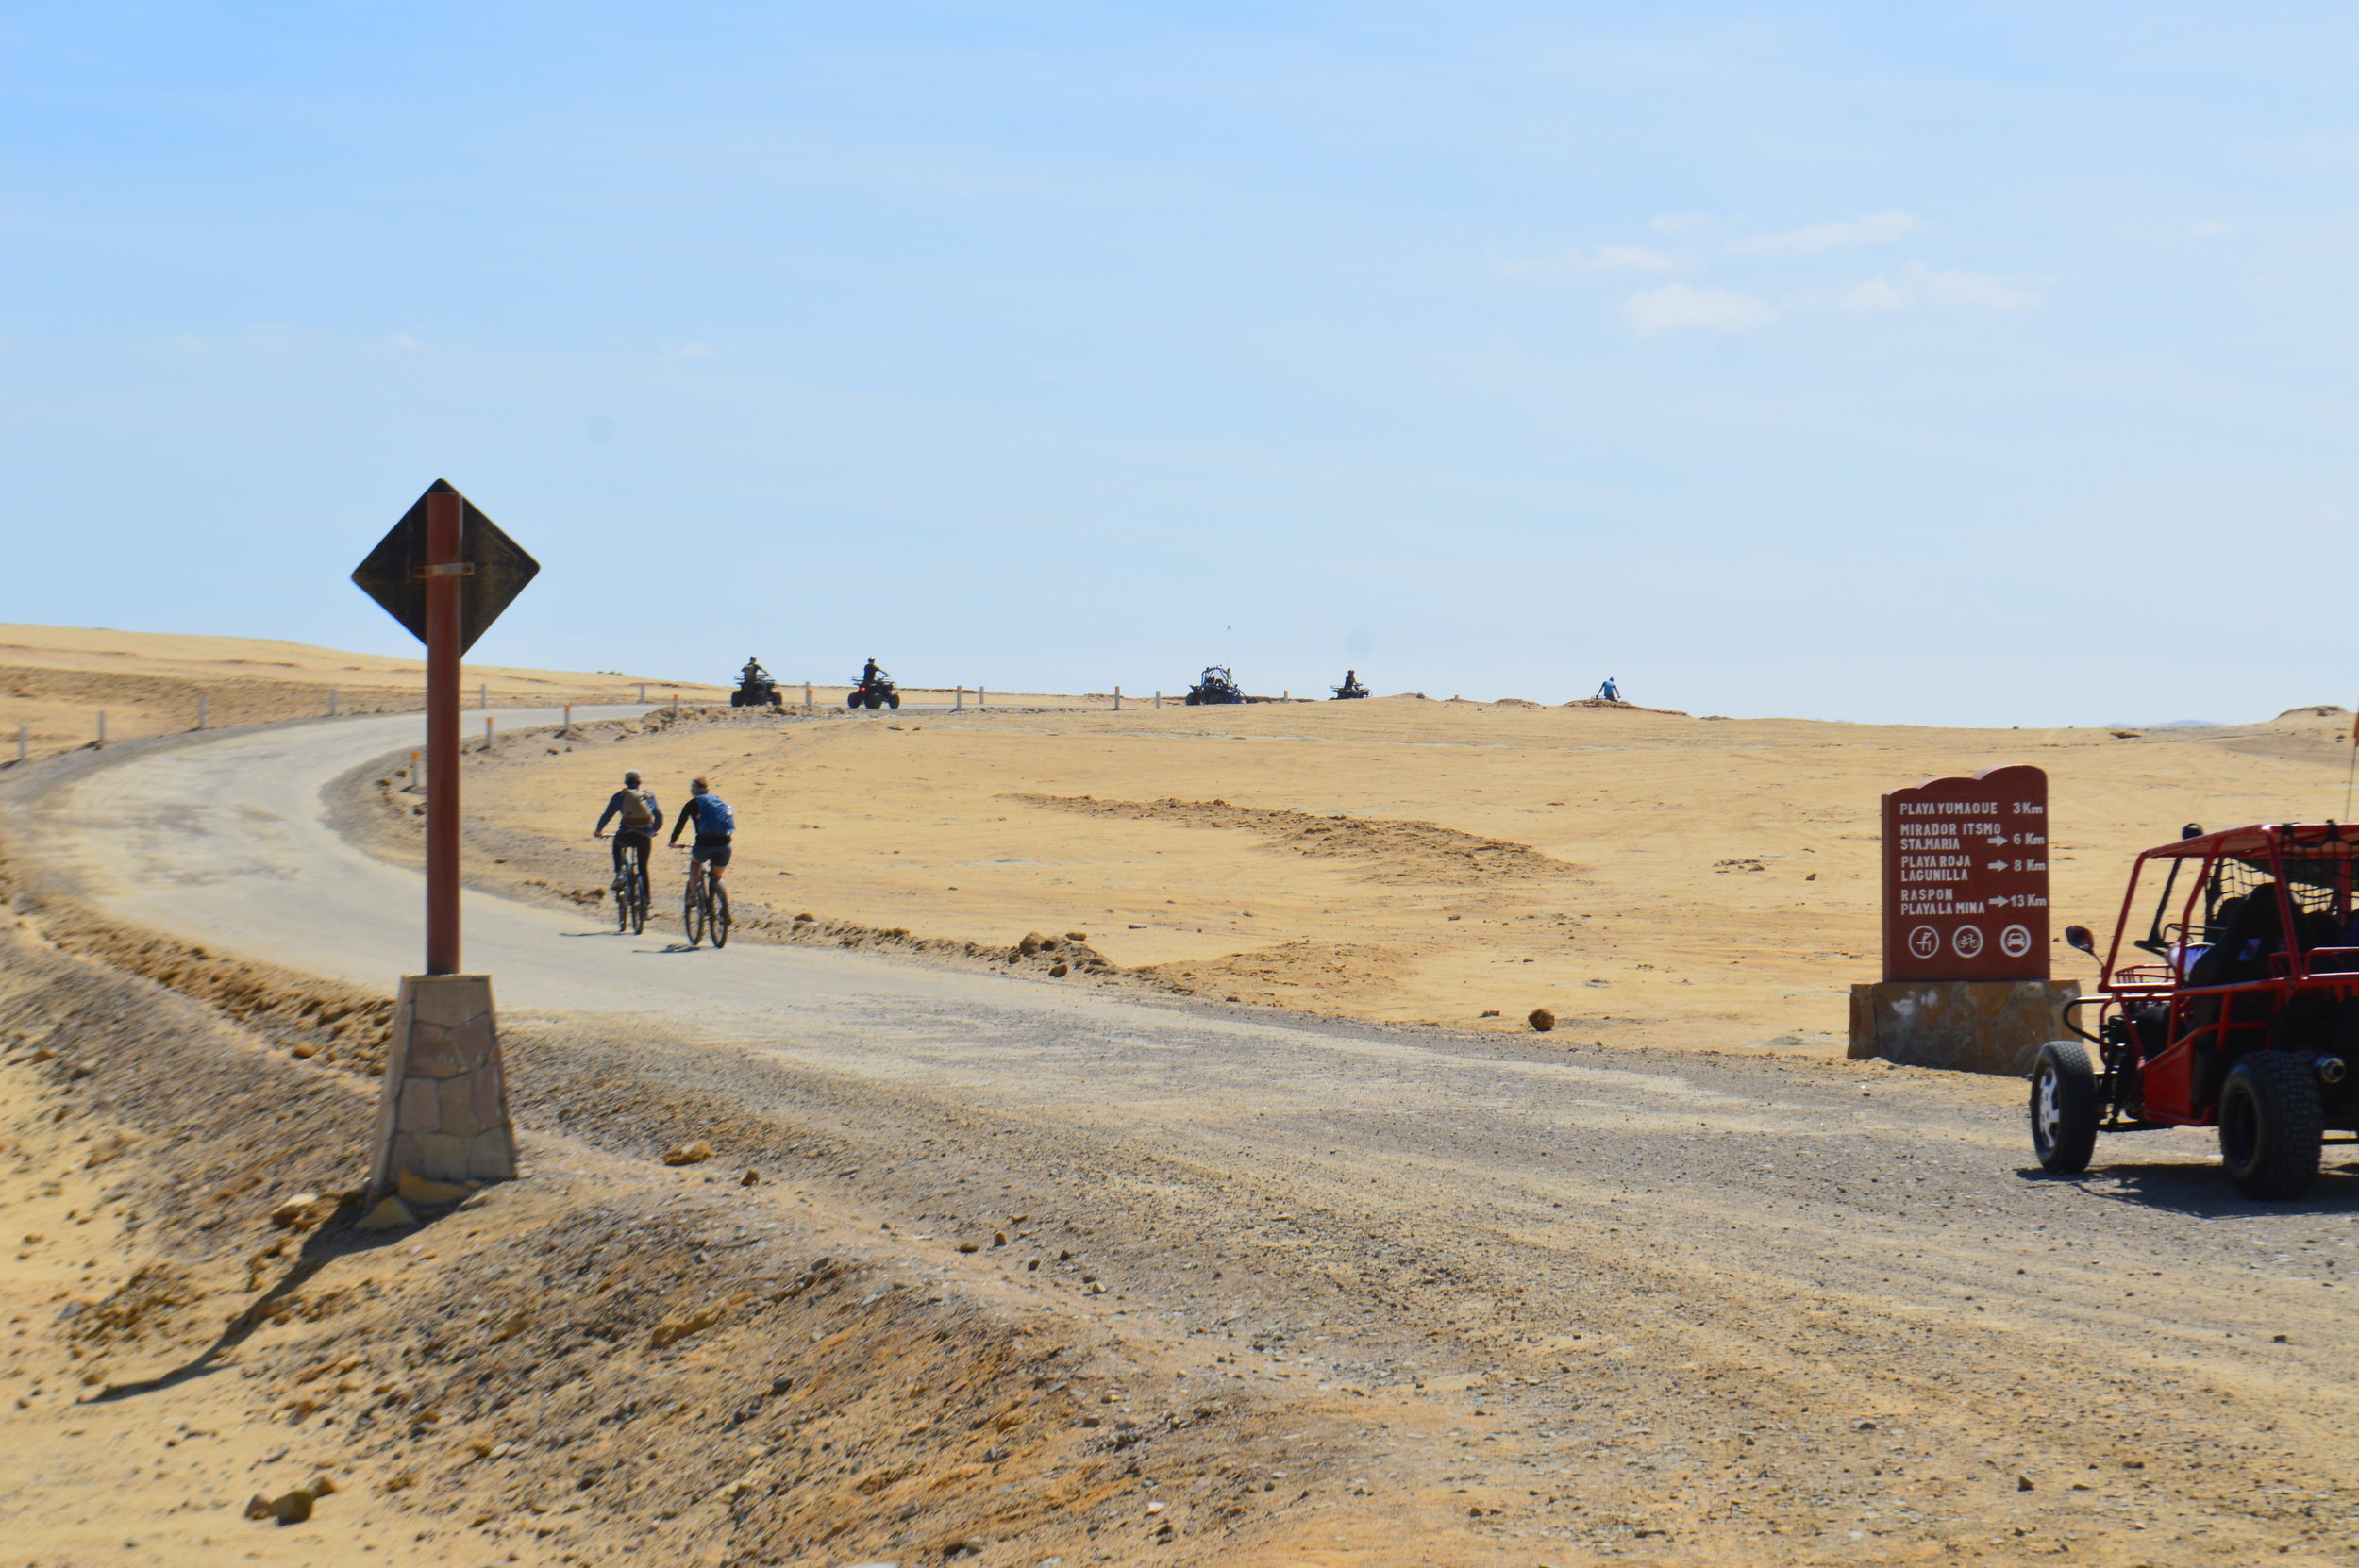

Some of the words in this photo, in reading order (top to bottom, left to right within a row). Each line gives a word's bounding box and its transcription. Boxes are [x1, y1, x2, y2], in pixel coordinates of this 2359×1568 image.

[1899, 802, 1935, 815] PLAYA
[1900, 823, 1957, 836] MIRADOR
[1963, 823, 2001, 835] ITSMO
[2013, 833, 2021, 845] 6
[2025, 832, 2045, 845] Km
[1901, 855, 1936, 868] PLAYA
[1939, 855, 1971, 867] ROJA
[2014, 859, 2022, 872] 8
[2026, 859, 2046, 872] Km
[1901, 869, 1968, 882] LAGUNILLA
[1901, 889, 1953, 901] RASPON
[2010, 894, 2025, 907] 13
[2028, 893, 2047, 907] Km
[1901, 902, 1936, 915] PLAYA
[1938, 902, 1953, 914] LA
[1955, 902, 1985, 914] MINA
